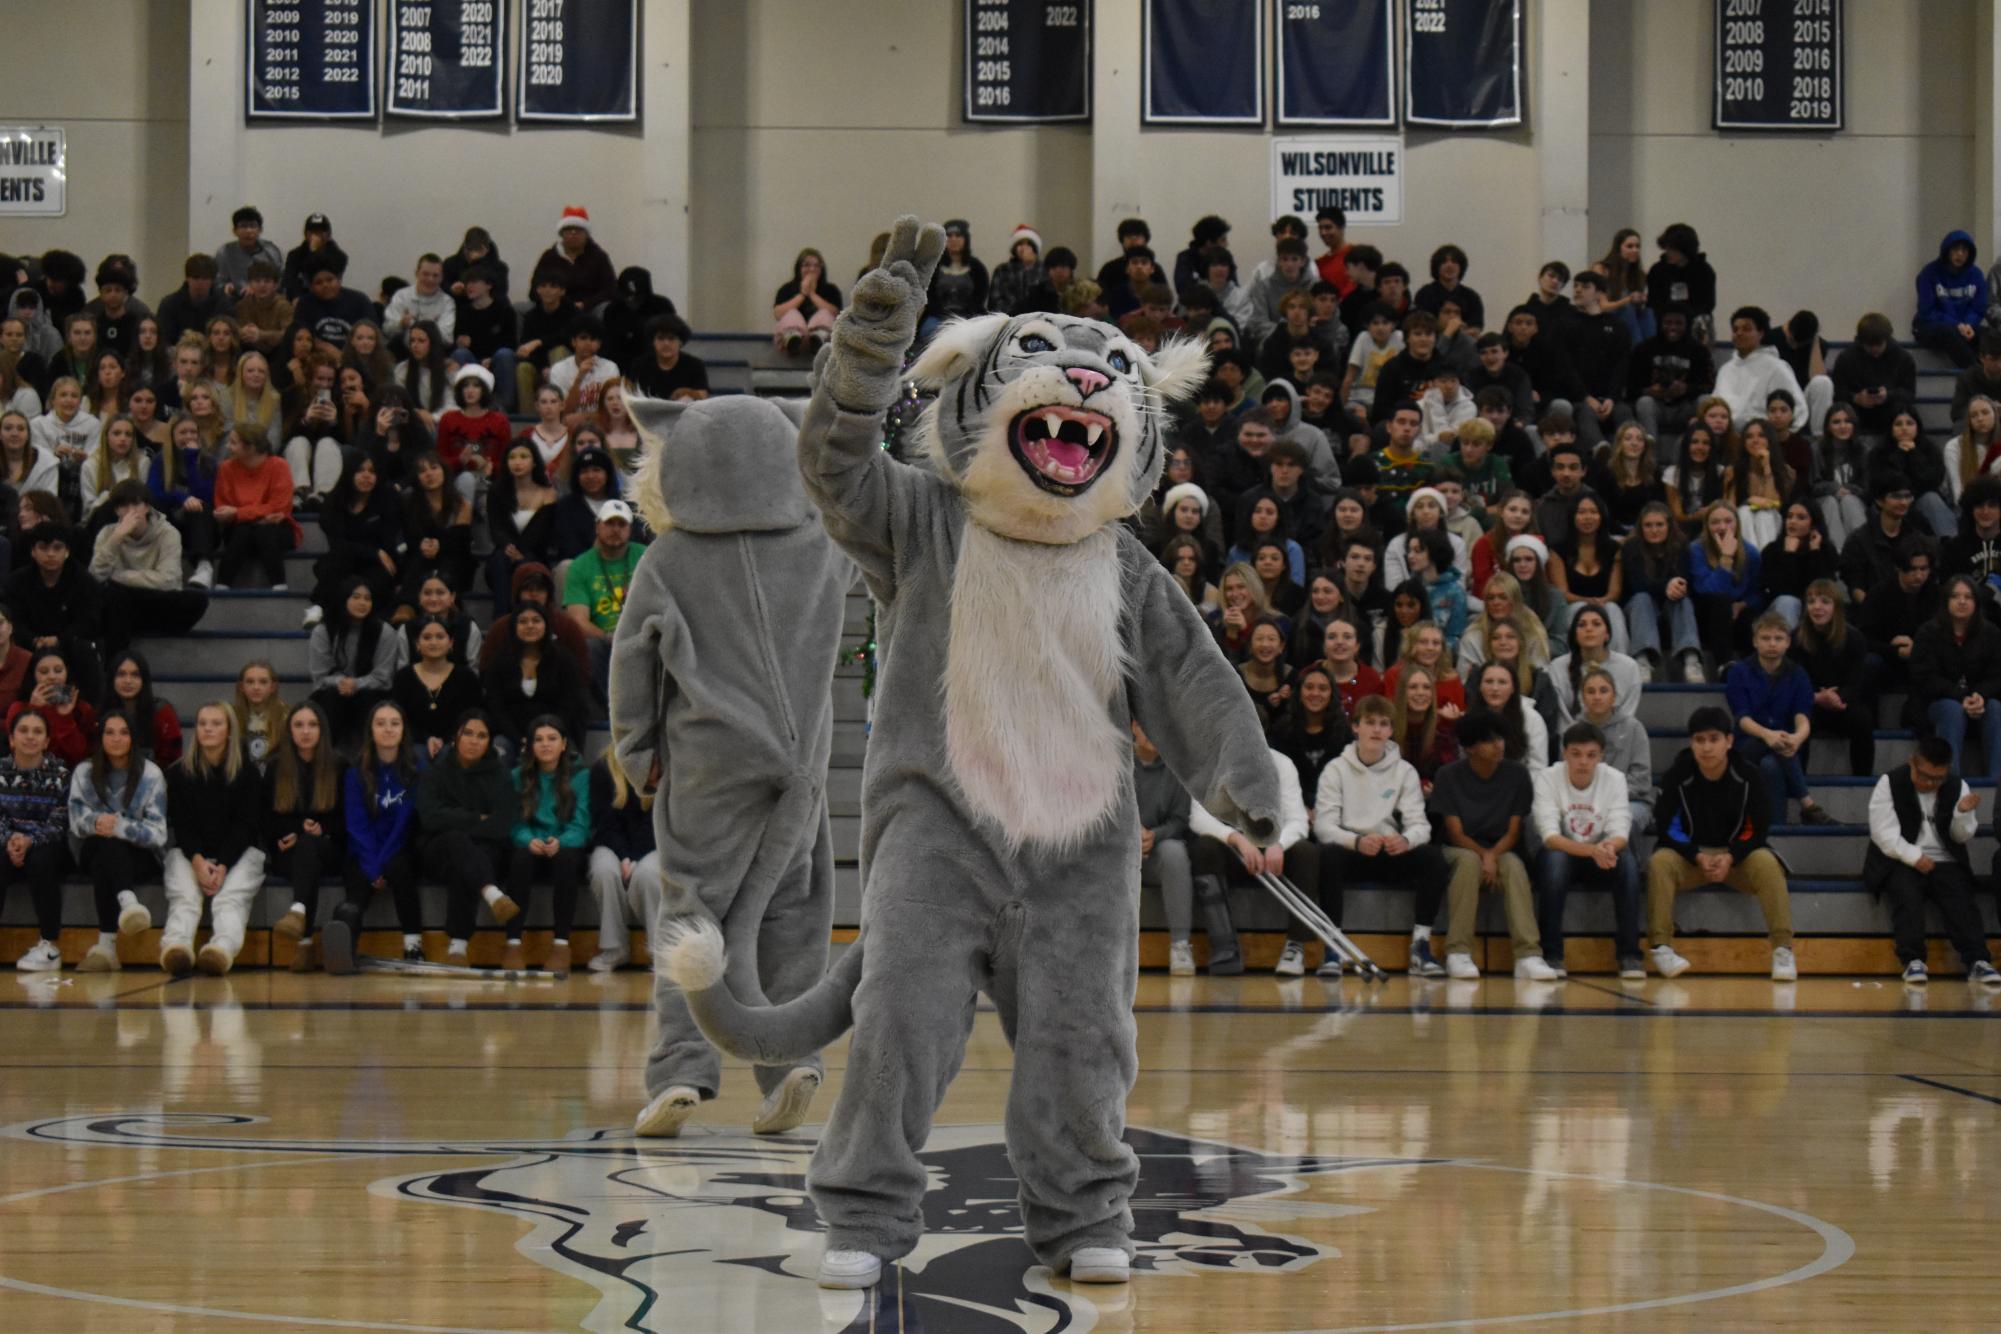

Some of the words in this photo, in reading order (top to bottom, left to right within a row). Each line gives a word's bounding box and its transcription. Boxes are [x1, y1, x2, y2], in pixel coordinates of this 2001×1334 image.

[266, 10, 300, 23] 2009
[324, 11, 359, 24] 2019
[401, 7, 432, 27] 2007
[461, 3, 493, 23] 2020
[531, 0, 564, 18] 2017
[1046, 6, 1077, 27] 2022
[1287, 5, 1320, 19] 2016
[1726, 0, 1763, 16] 2007
[1793, 0, 1830, 15] 2014
[531, 21, 563, 41] 2018
[978, 11, 1008, 31] 2004
[1415, 12, 1446, 32] 2022
[265, 29, 300, 42] 2010
[324, 30, 359, 43] 2020
[401, 31, 431, 52] 2008
[461, 25, 492, 45] 2021
[1726, 21, 1764, 44] 2008
[1793, 20, 1831, 43] 2015
[265, 48, 298, 61] 2011
[324, 49, 358, 62] 2021
[531, 43, 563, 63] 2019
[978, 36, 1009, 55] 2014
[400, 54, 432, 76] 2010
[461, 46, 493, 67] 2022
[1725, 49, 1764, 73] 2009
[1793, 47, 1831, 70] 2016
[265, 67, 300, 80] 2012
[323, 68, 359, 81] 2022
[531, 64, 563, 85] 2020
[978, 61, 1011, 81] 2015
[264, 86, 300, 99] 2015
[399, 77, 430, 99] 2011
[978, 86, 1011, 105] 2016
[1725, 78, 1764, 101] 2010
[1793, 76, 1831, 99] 2018
[1790, 100, 1832, 118] 2019
[1281, 151, 1395, 176] WILSONVILLE
[0, 177, 45, 202] ENTS
[1293, 187, 1384, 212] STUDENTS
